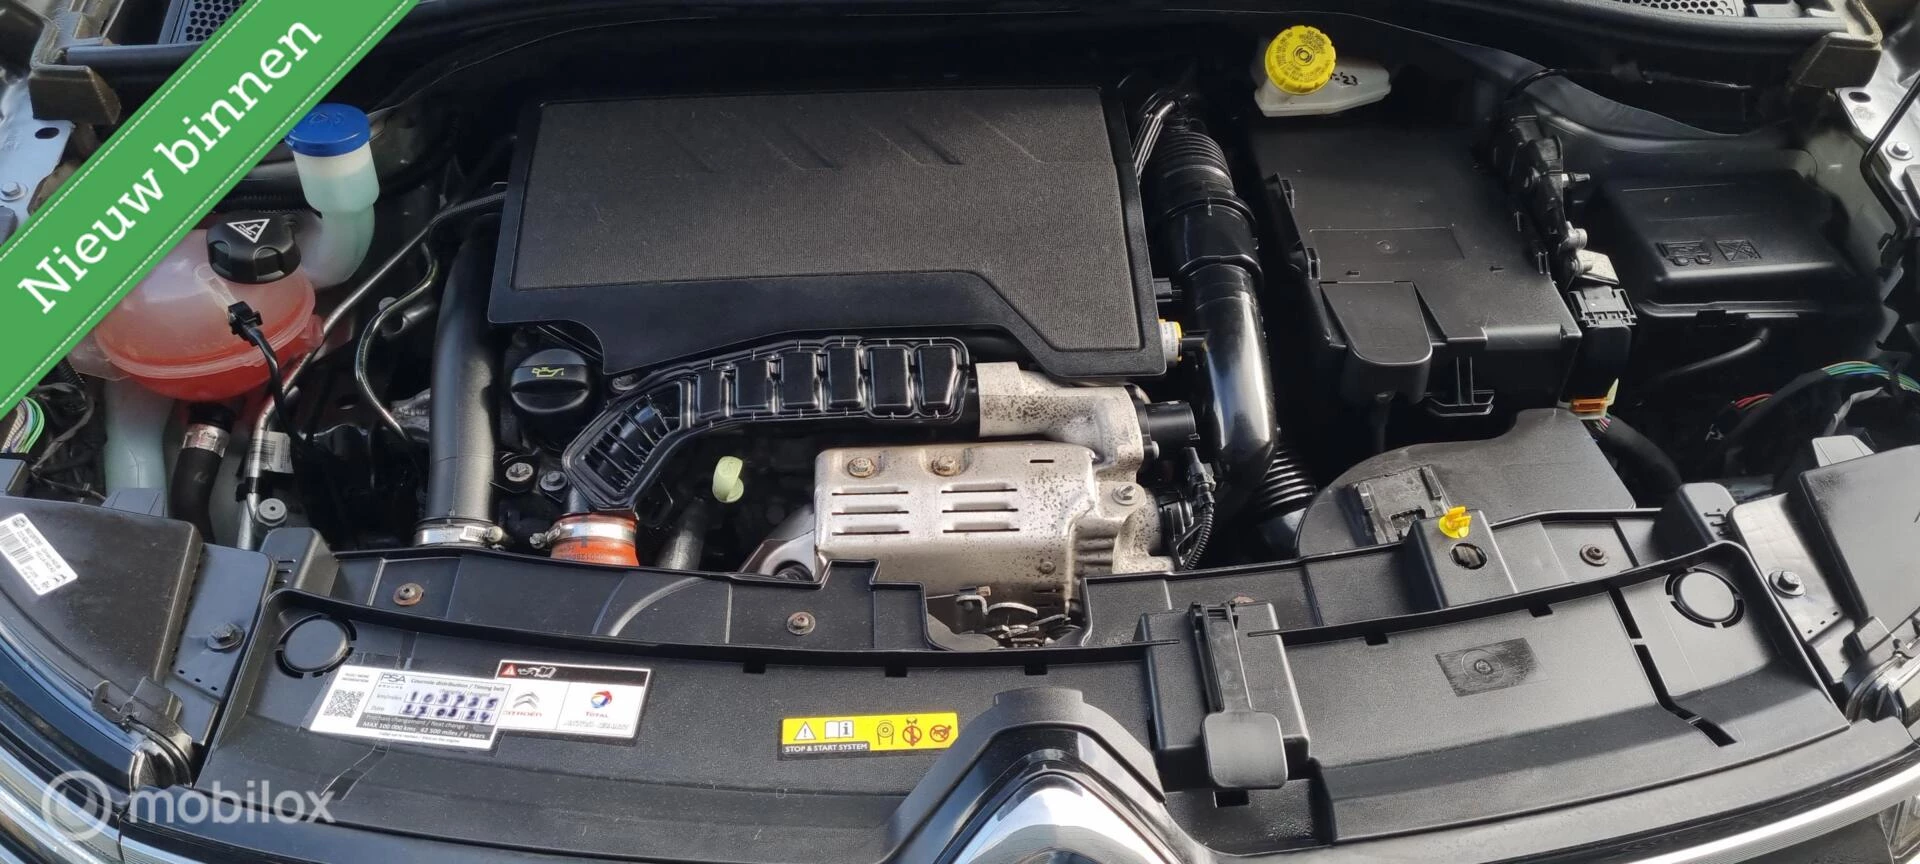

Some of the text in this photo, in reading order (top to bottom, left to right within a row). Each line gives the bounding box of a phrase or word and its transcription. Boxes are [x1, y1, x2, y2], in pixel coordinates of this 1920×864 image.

[380, 673, 406, 684] PSA
[436, 681, 468, 689] distribution
[785, 745, 806, 753] STOP
[812, 744, 838, 752] START
[838, 743, 868, 751] SYSTEM
